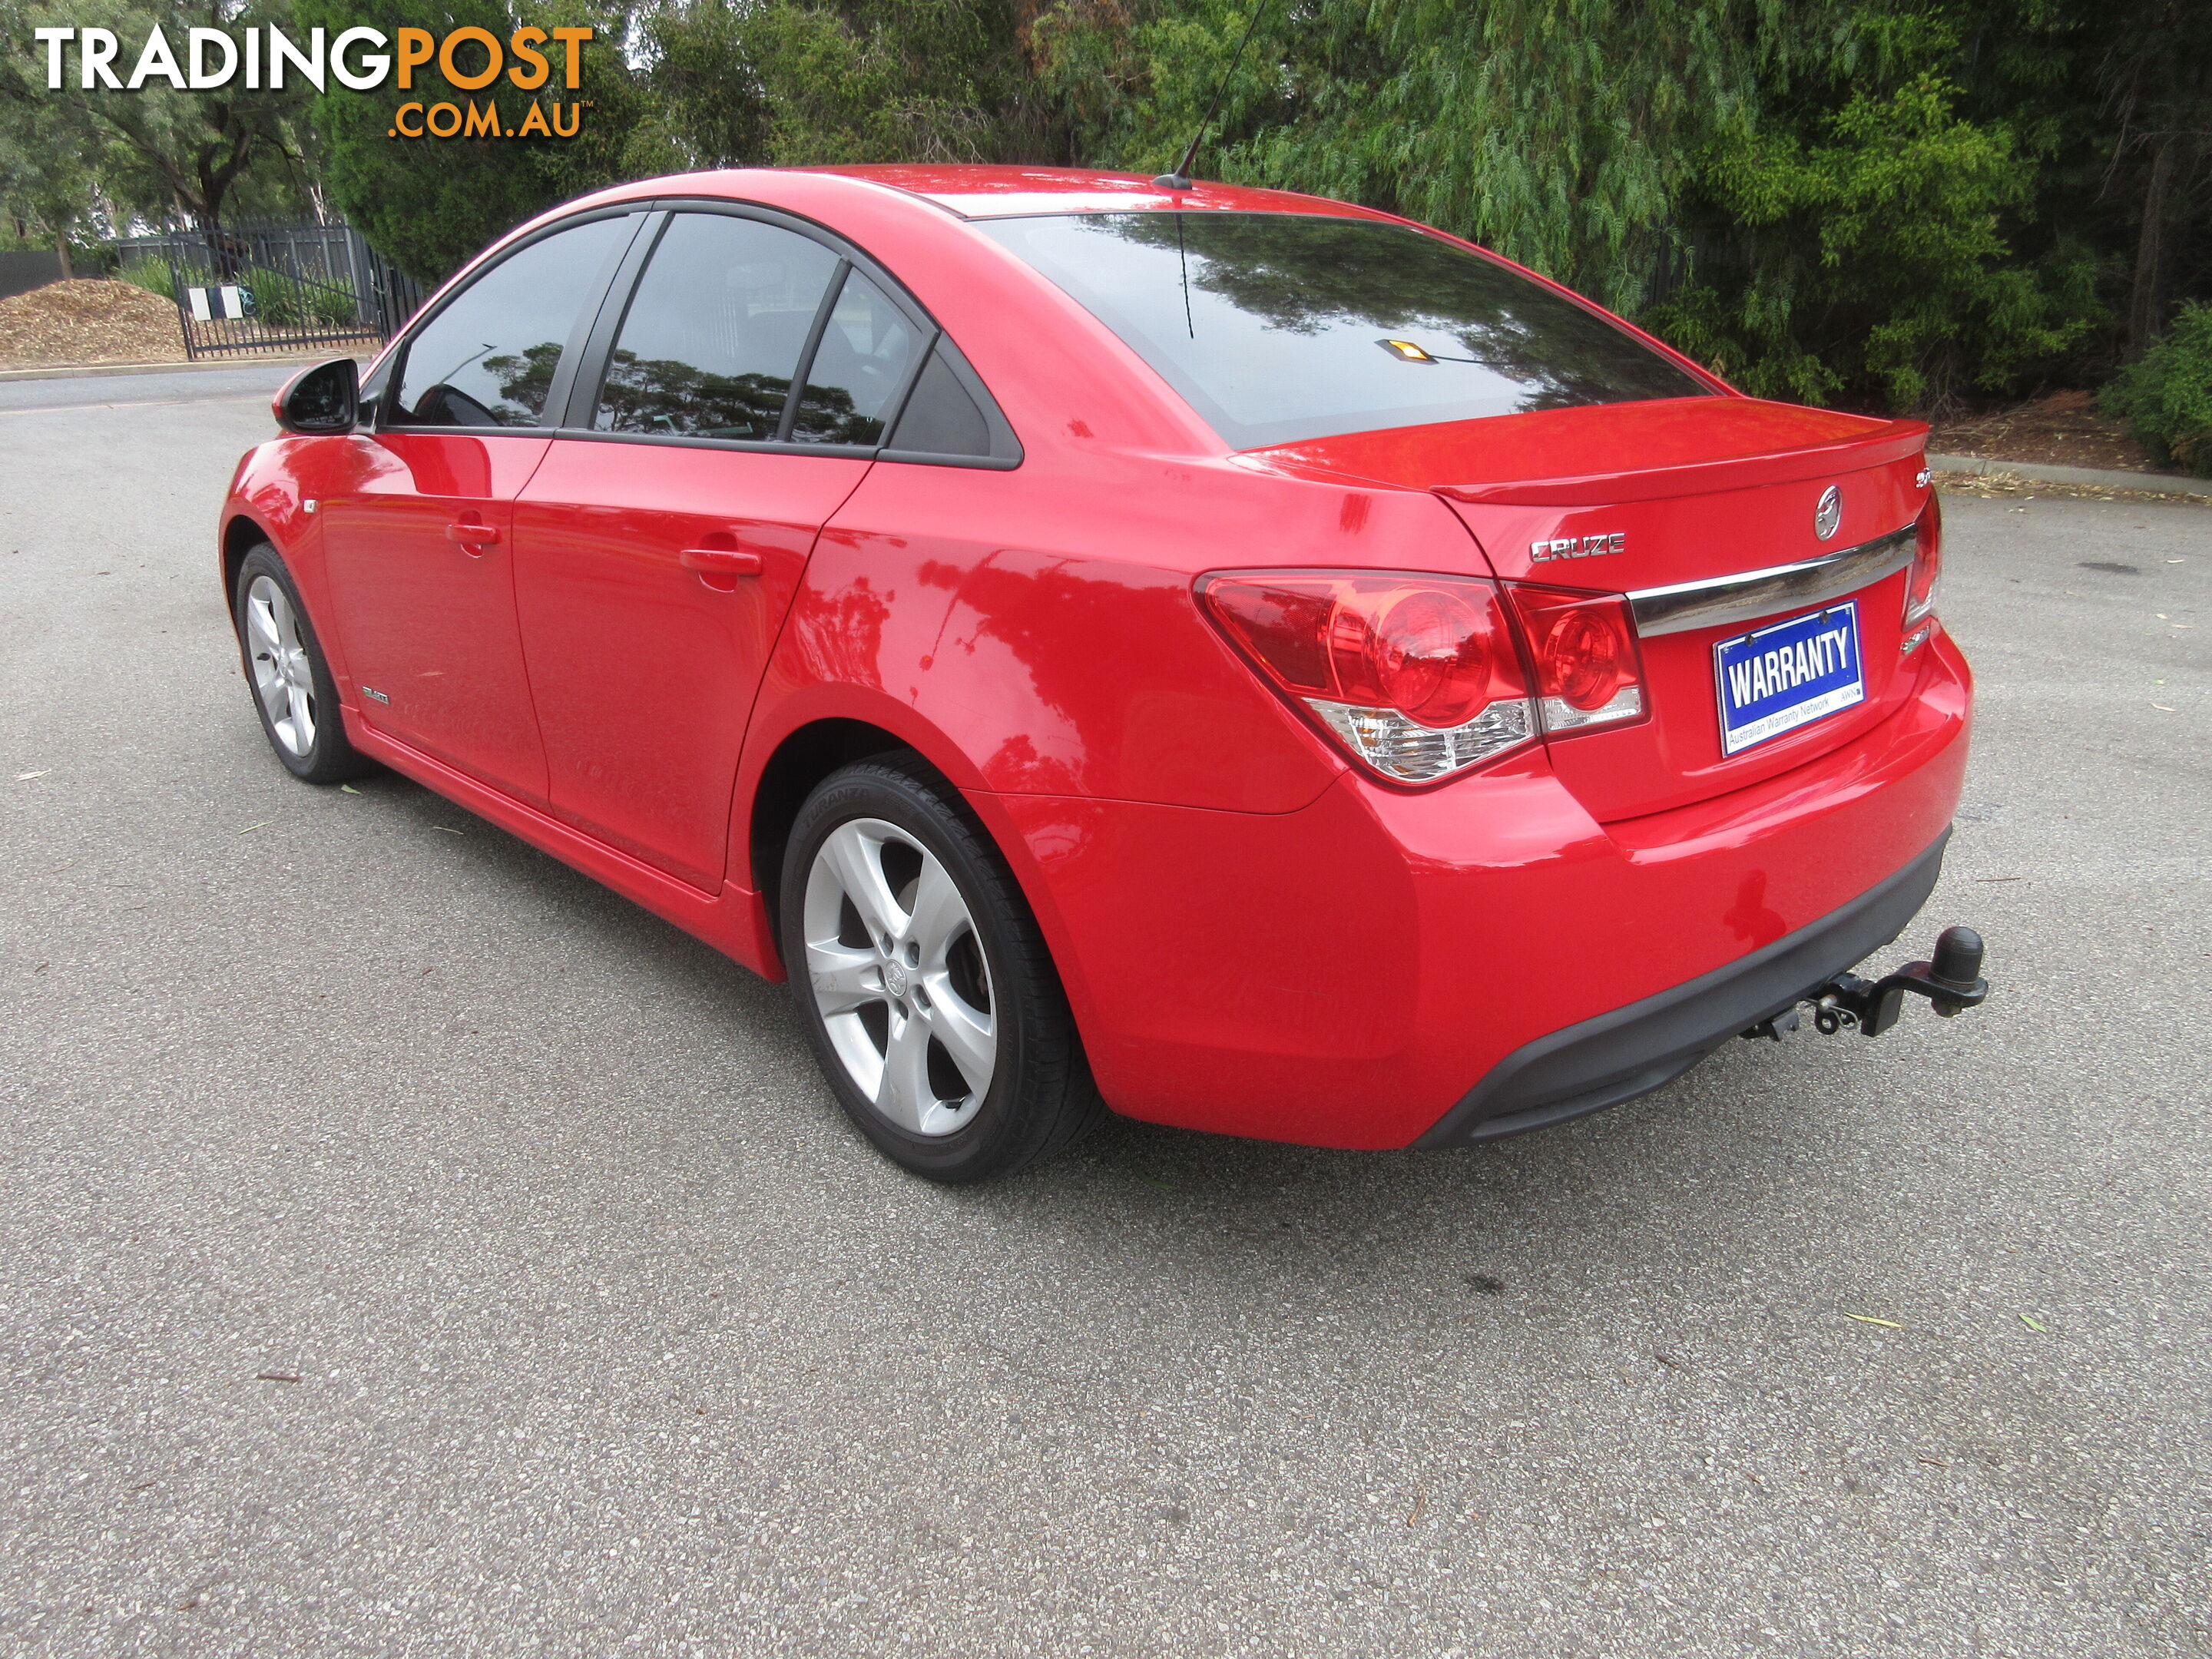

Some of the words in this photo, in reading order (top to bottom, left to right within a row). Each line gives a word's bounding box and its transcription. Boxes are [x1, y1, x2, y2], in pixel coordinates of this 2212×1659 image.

[1531, 532, 1625, 562] CRUZE
[1728, 627, 1848, 709] WARRANTY
[1729, 724, 1765, 746] Australian
[1767, 709, 1799, 730] Warranty
[1800, 697, 1830, 717] Network
